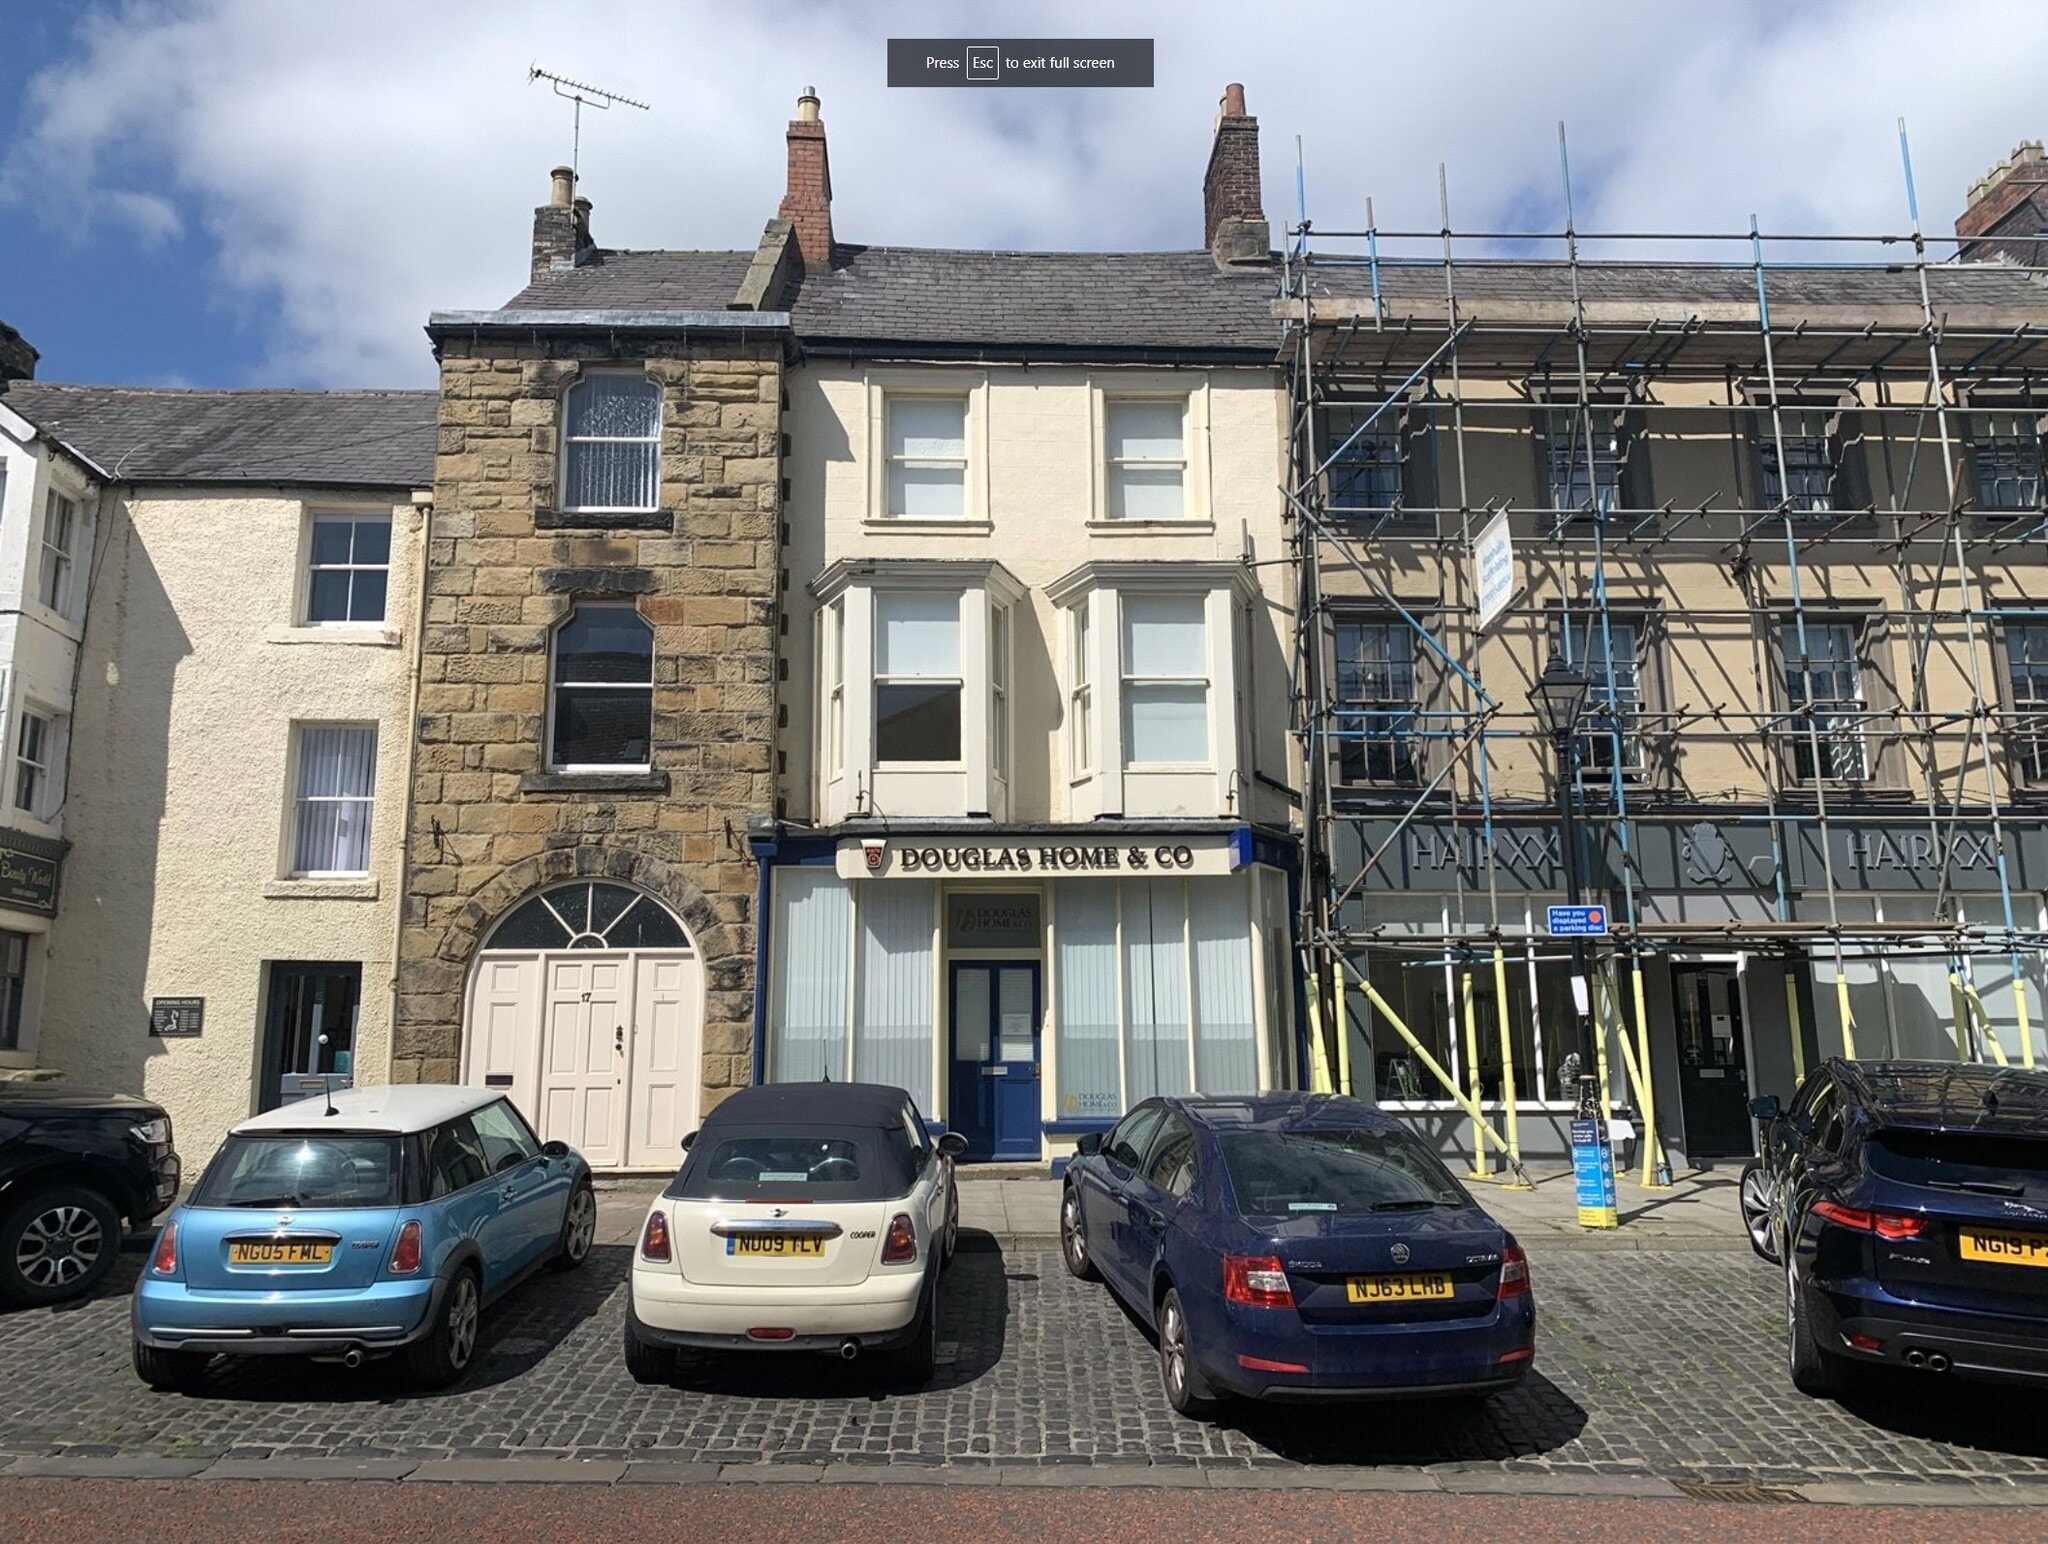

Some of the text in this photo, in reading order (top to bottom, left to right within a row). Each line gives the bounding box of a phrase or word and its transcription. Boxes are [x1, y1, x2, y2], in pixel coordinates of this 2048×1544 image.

[900, 845, 1193, 867] DOUGLAS HOME & CO
[977, 908, 1032, 918] DOUGLAS
[1572, 910, 1586, 918] you
[1552, 917, 1587, 925] displayed
[581, 992, 592, 1003] 17
[850, 1230, 876, 1239] COOPER
[739, 1235, 823, 1252] NU09 TLV
[1973, 1234, 2023, 1256] NG19
[237, 1243, 323, 1260] NG05 FML
[1355, 1275, 1445, 1298] NJ63 LHB
